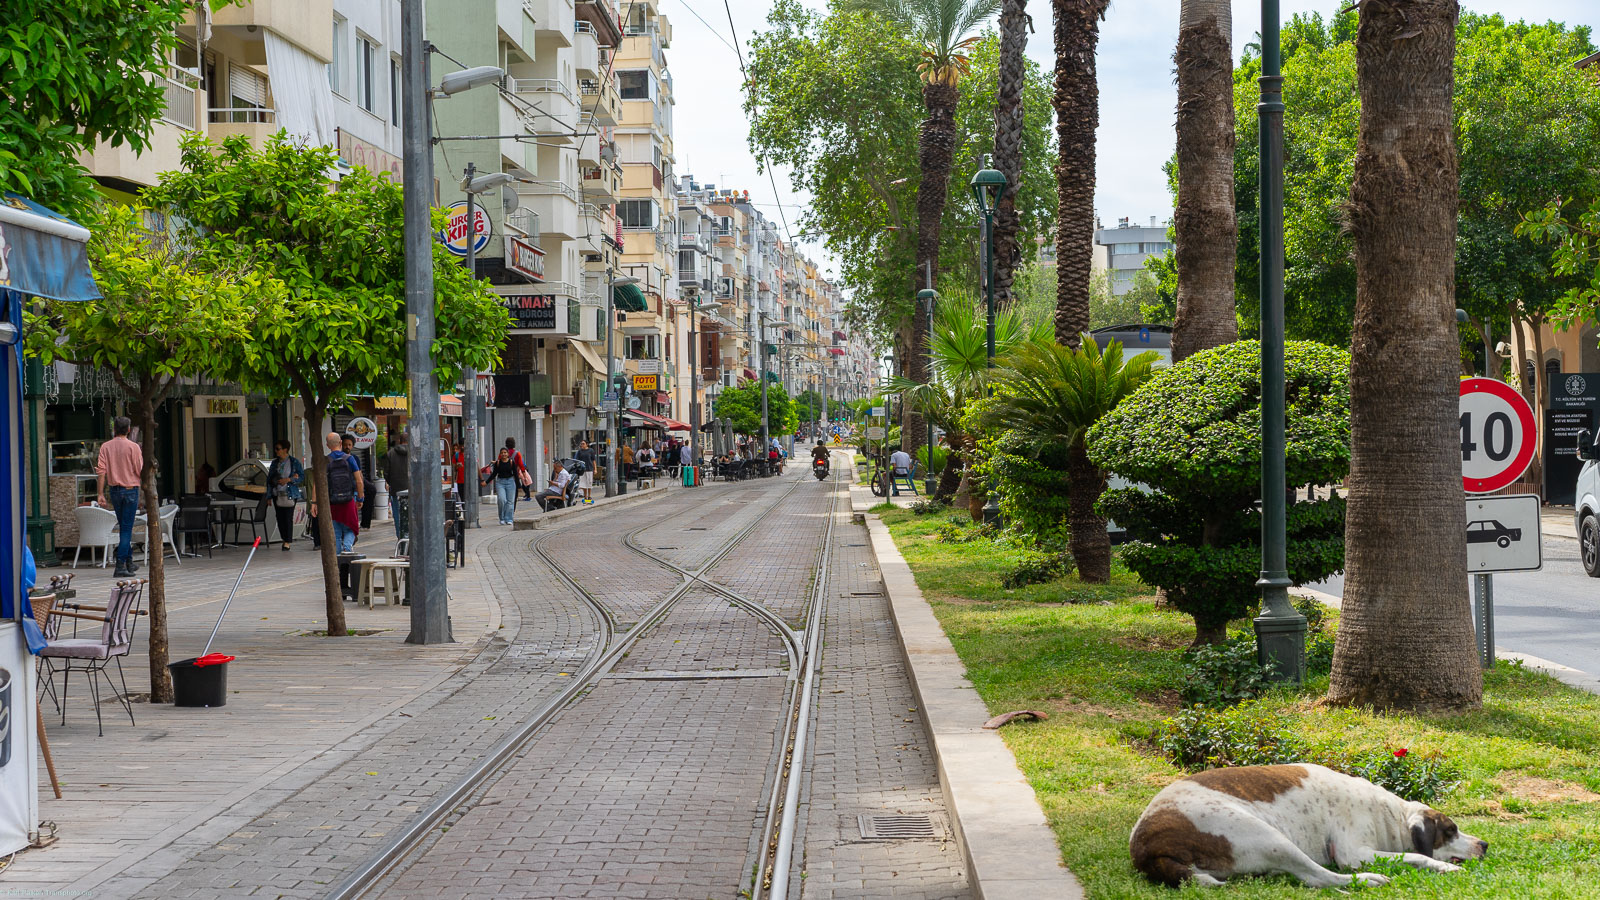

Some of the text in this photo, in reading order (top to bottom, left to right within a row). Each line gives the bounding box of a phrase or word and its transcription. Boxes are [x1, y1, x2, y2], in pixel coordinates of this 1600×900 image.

[448, 219, 484, 243] KING
[503, 296, 551, 308] AKMAN
[520, 309, 554, 318] BÜROSU
[635, 376, 655, 384] FOTO
[1459, 411, 1513, 461] 40
